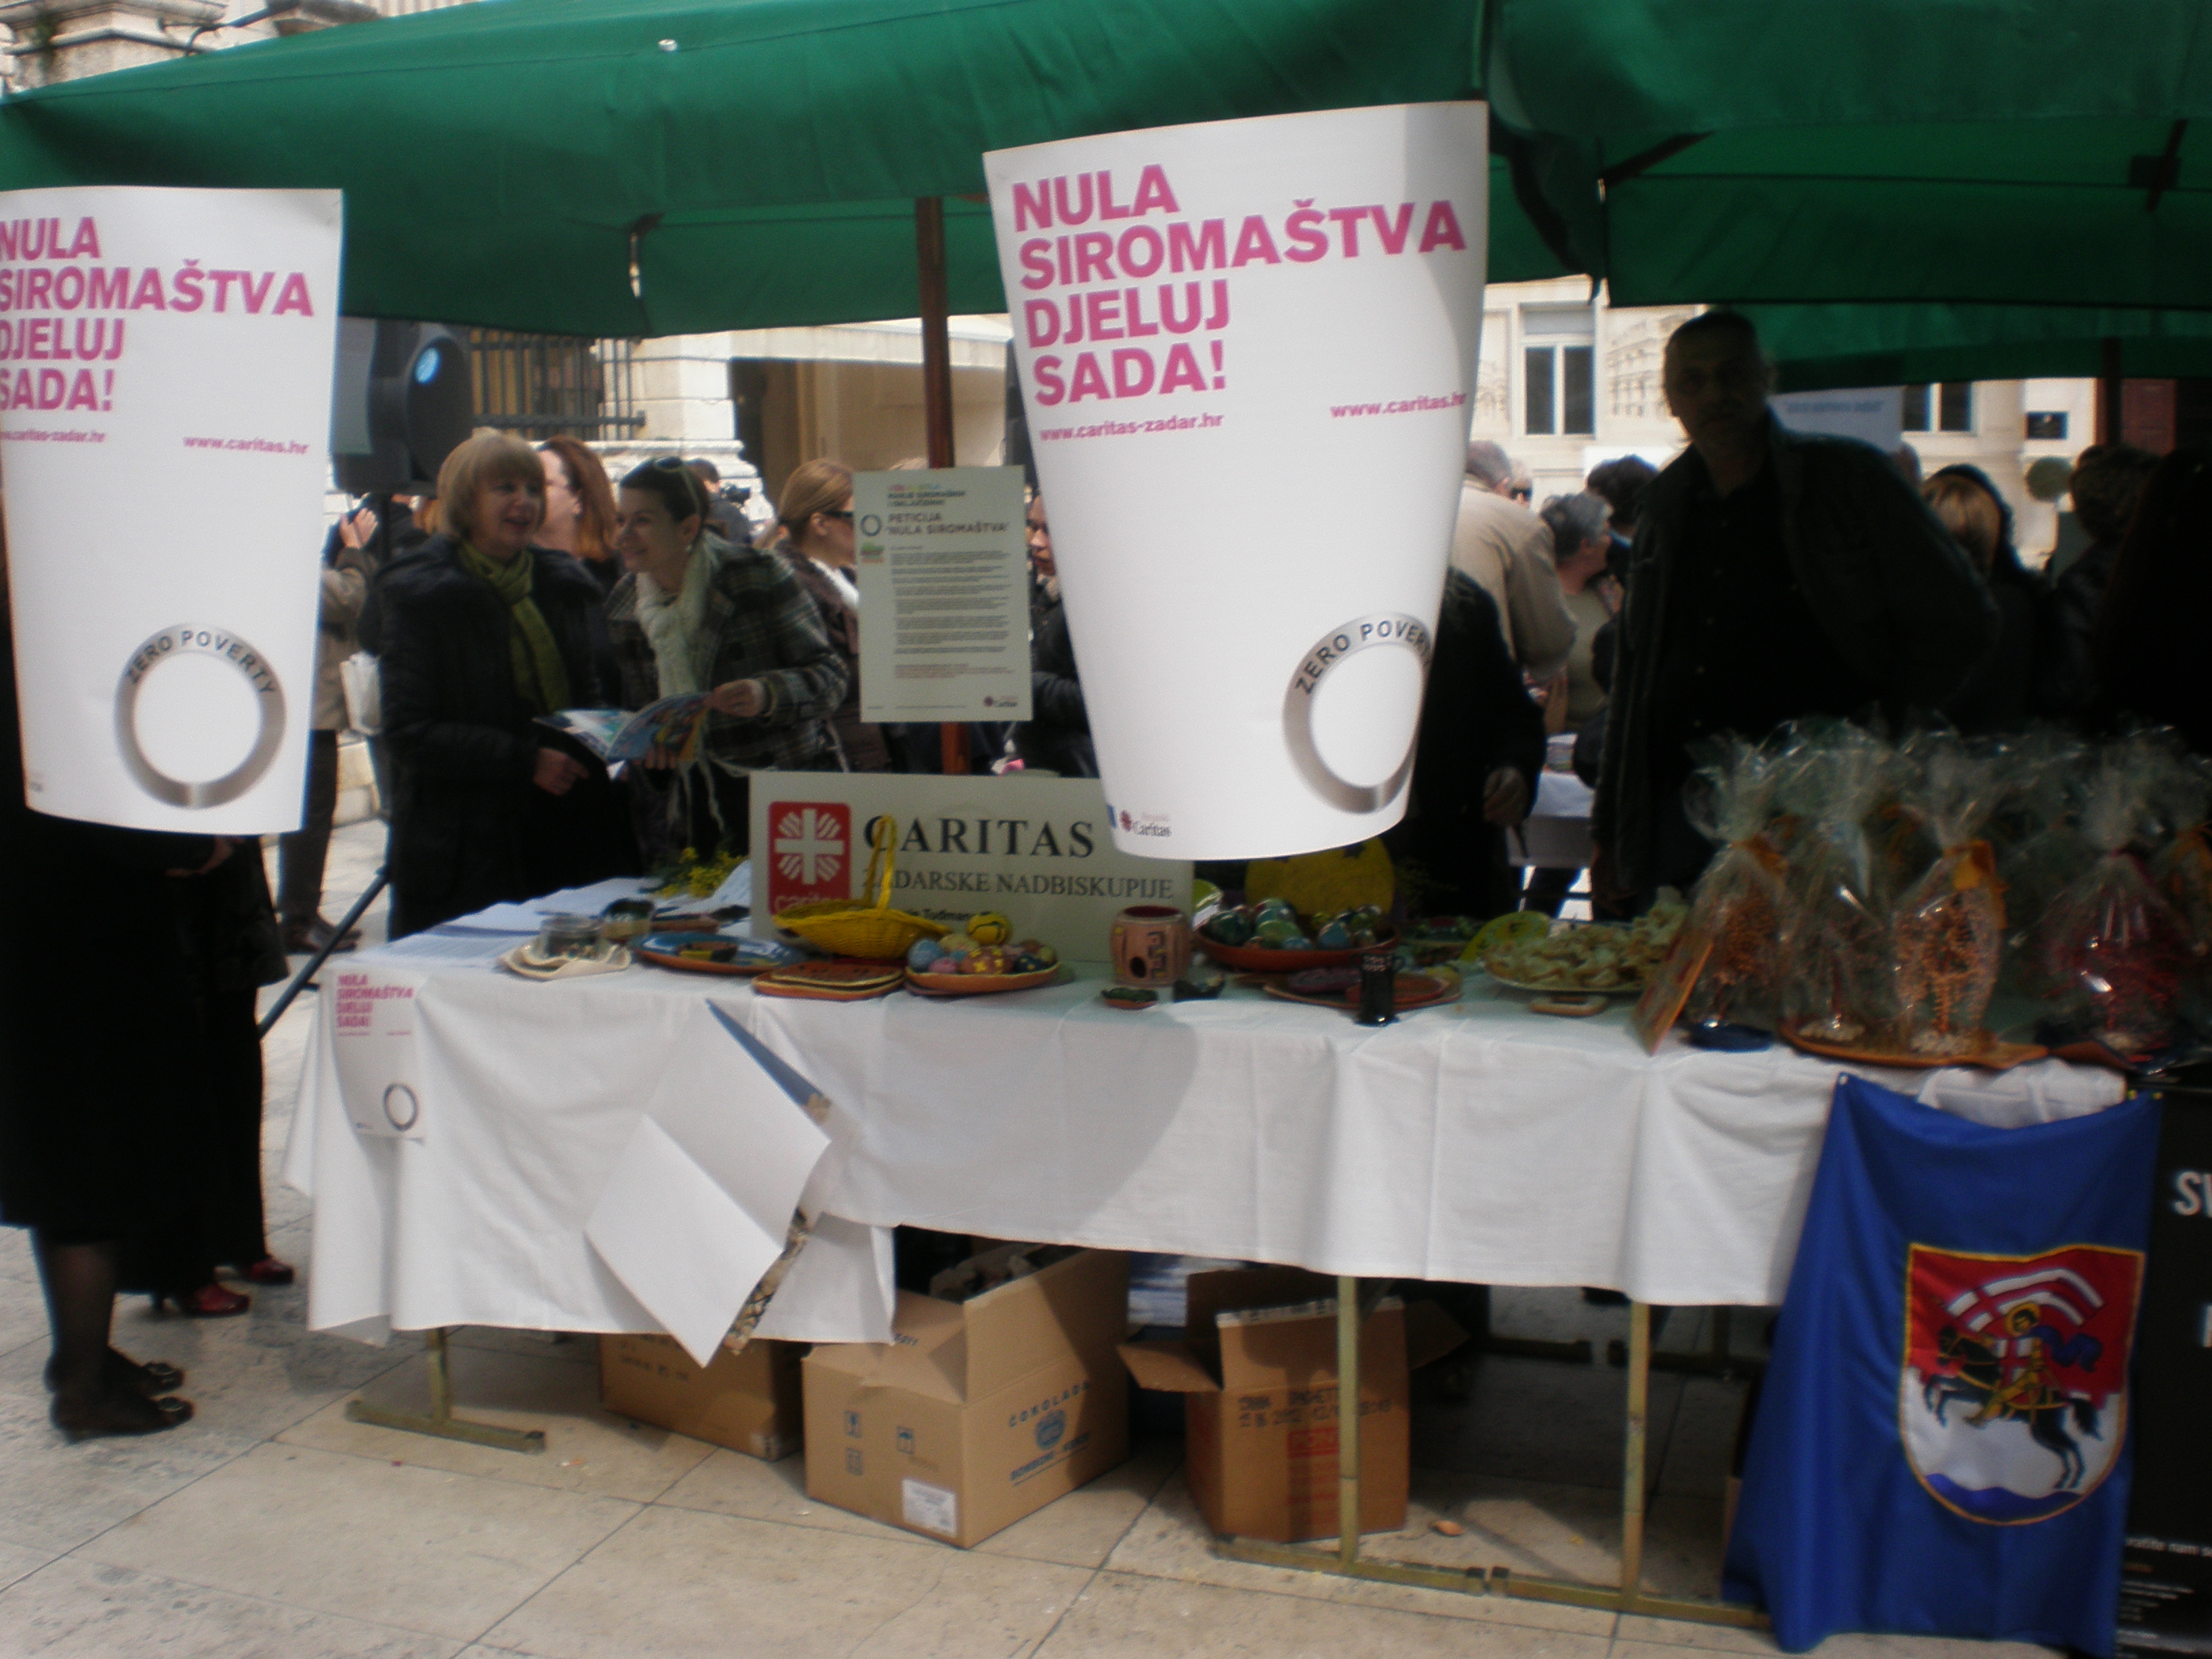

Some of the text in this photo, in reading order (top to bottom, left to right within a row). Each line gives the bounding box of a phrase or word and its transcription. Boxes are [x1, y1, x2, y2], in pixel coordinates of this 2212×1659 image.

[1012, 164, 1181, 233] NULA
[0, 216, 101, 261] NULA
[1019, 197, 1468, 290] SIROMAŠTVA
[0, 258, 315, 318] SIROMAŠTVA
[1023, 279, 1231, 348] DJELUJ
[1033, 340, 1227, 407] SADA!
[1040, 412, 1224, 441] www.caritas-zadar.hr
[181, 630, 274, 693] POVERTY
[1295, 634, 1351, 695] ZERO
[863, 816, 1095, 859] CARITAS
[995, 874, 1174, 899] NADBISKUPIJE
